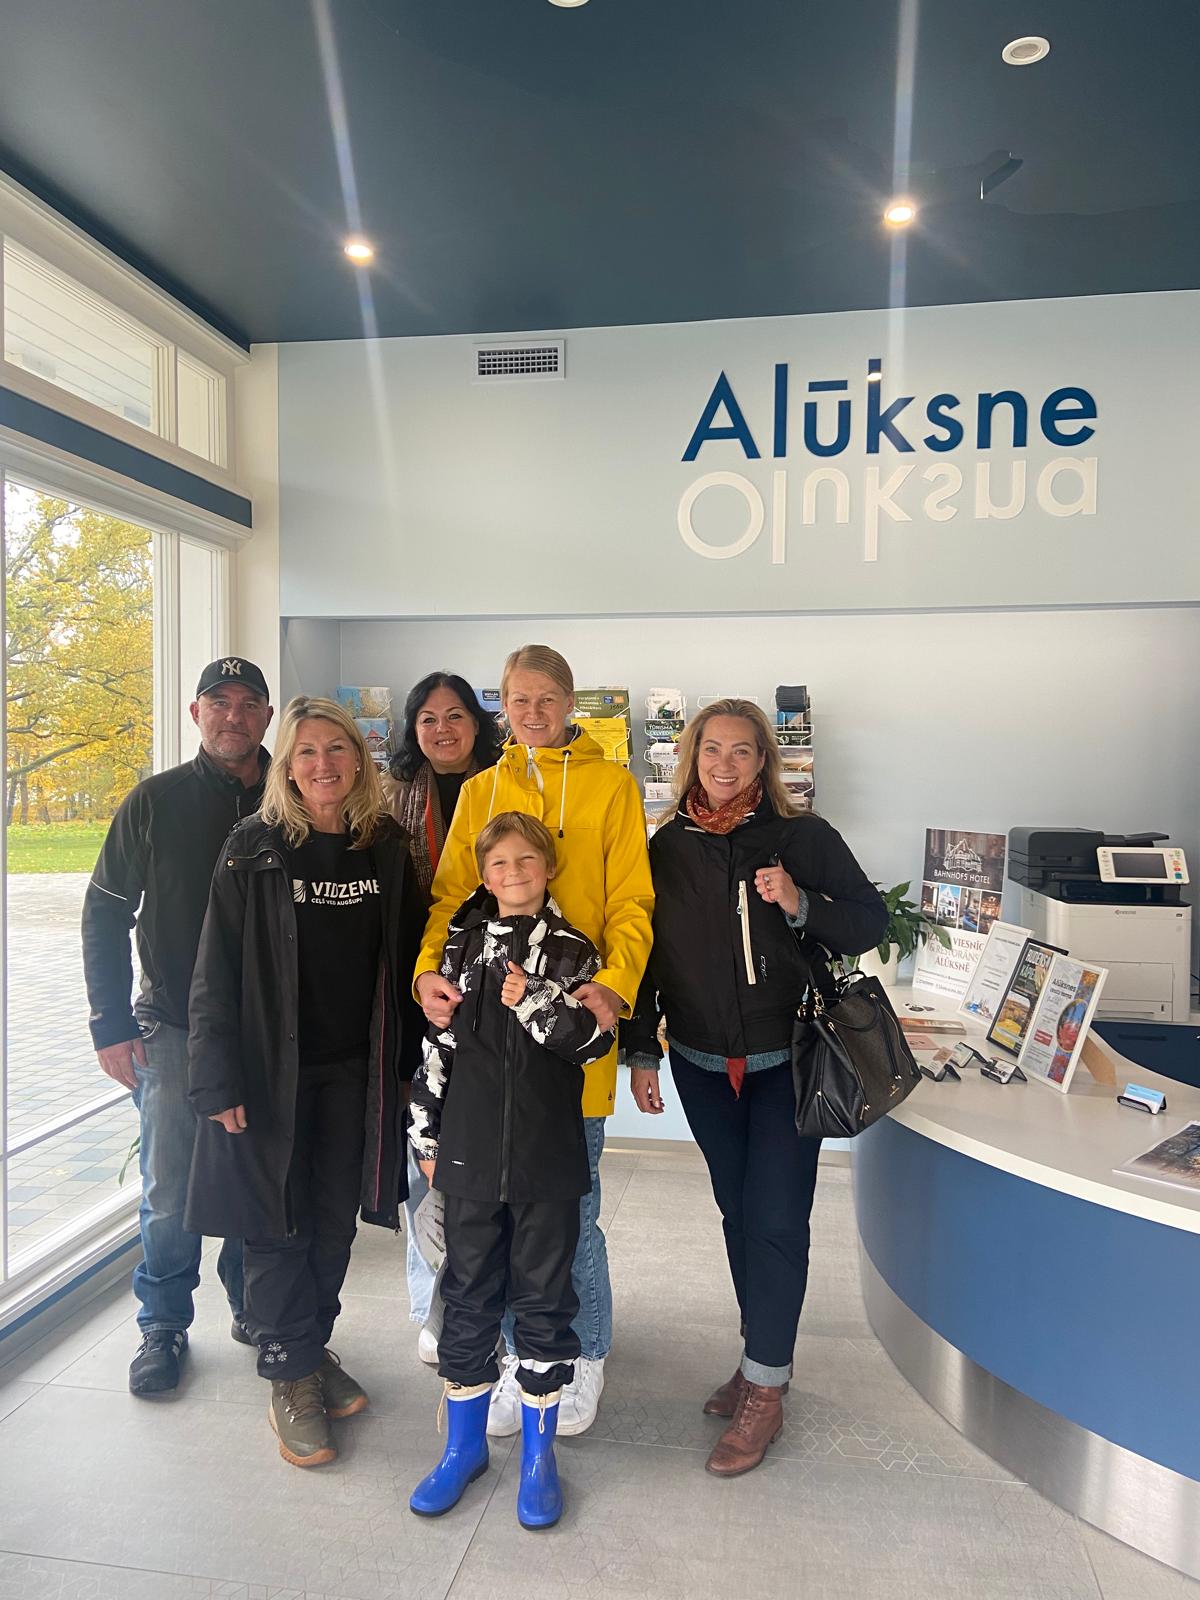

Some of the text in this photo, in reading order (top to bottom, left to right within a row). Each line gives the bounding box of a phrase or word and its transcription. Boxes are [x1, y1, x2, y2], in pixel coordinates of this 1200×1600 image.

[681, 358, 1098, 462] Alūksne
[933, 869, 990, 884] BAHNHOFS HOTEL
[311, 879, 380, 898] VIDZEME
[953, 936, 985, 951] VIESNĪC
